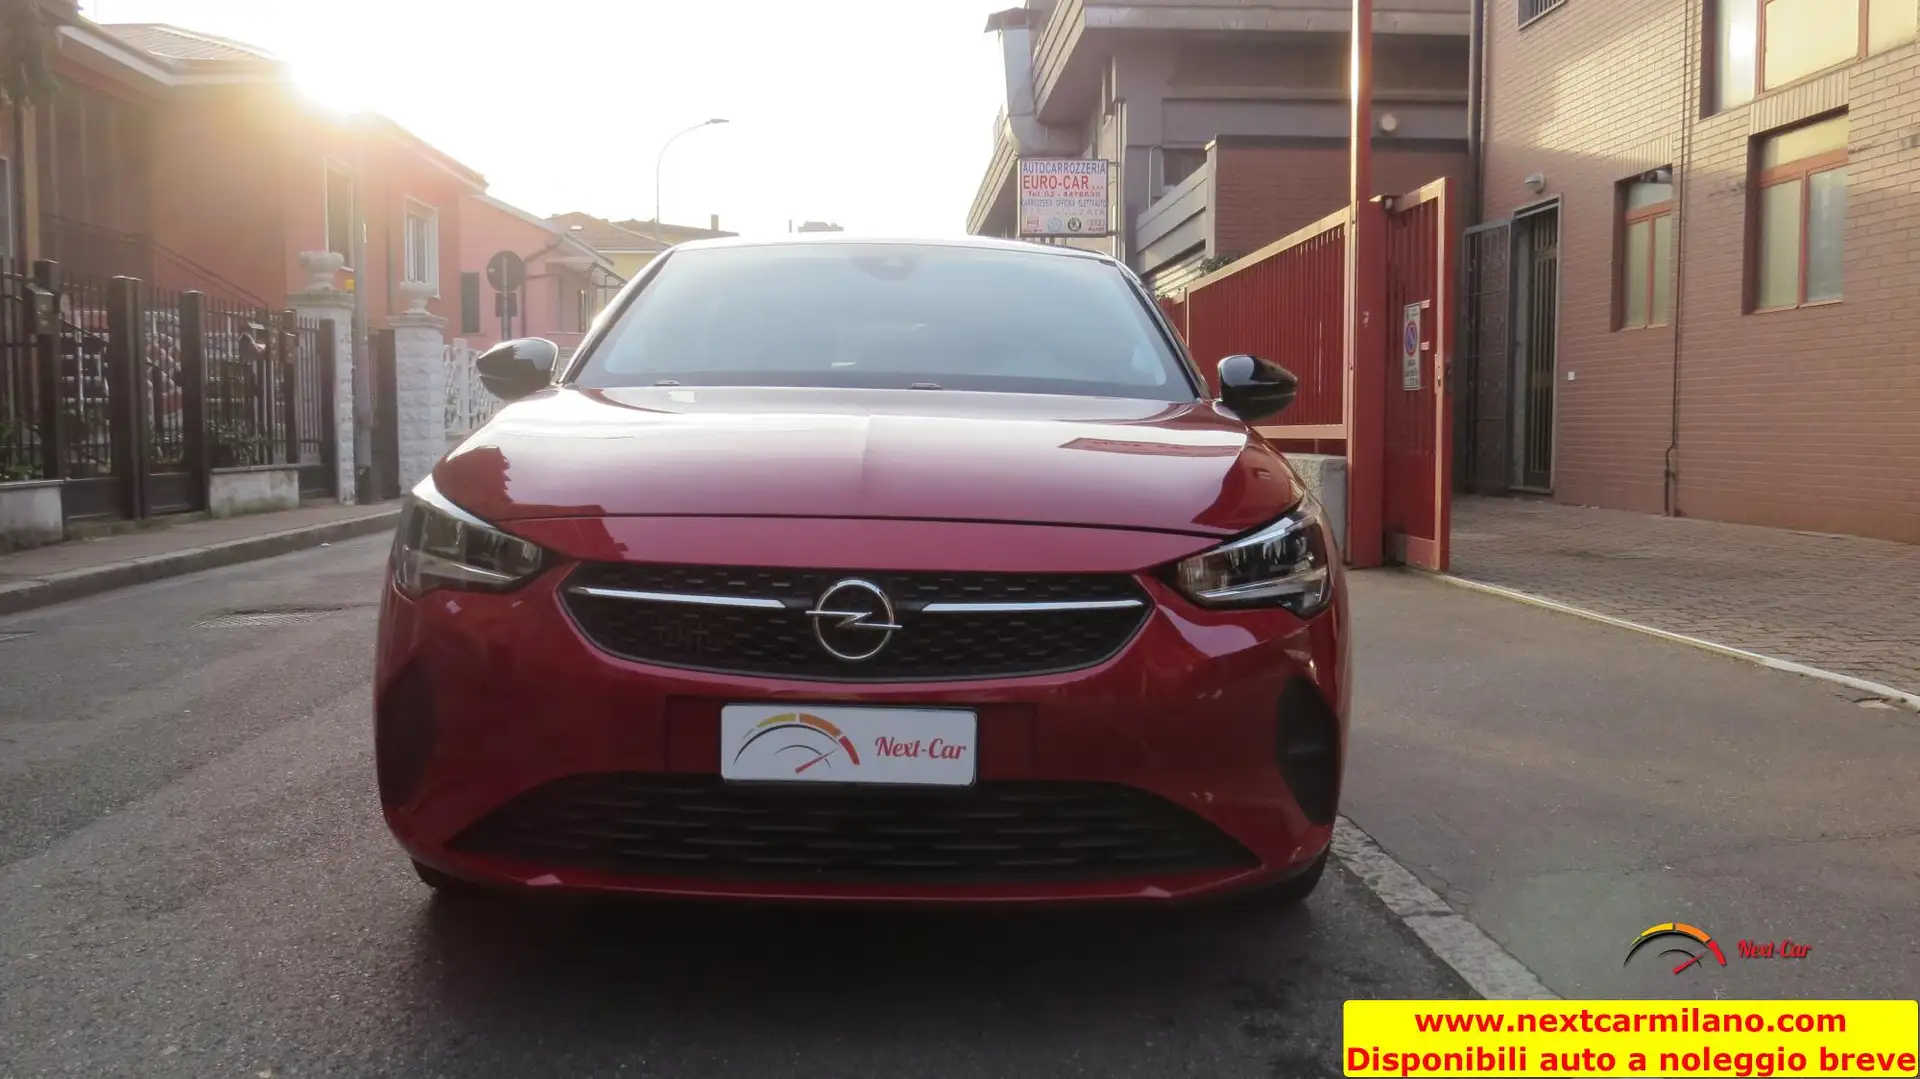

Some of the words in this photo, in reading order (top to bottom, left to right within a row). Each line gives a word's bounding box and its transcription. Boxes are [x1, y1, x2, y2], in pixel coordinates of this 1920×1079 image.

[1022, 161, 1106, 175] AUTOCARROZZERIA
[1023, 175, 1089, 190] EURO-CAR
[875, 735, 967, 760] Next-Car
